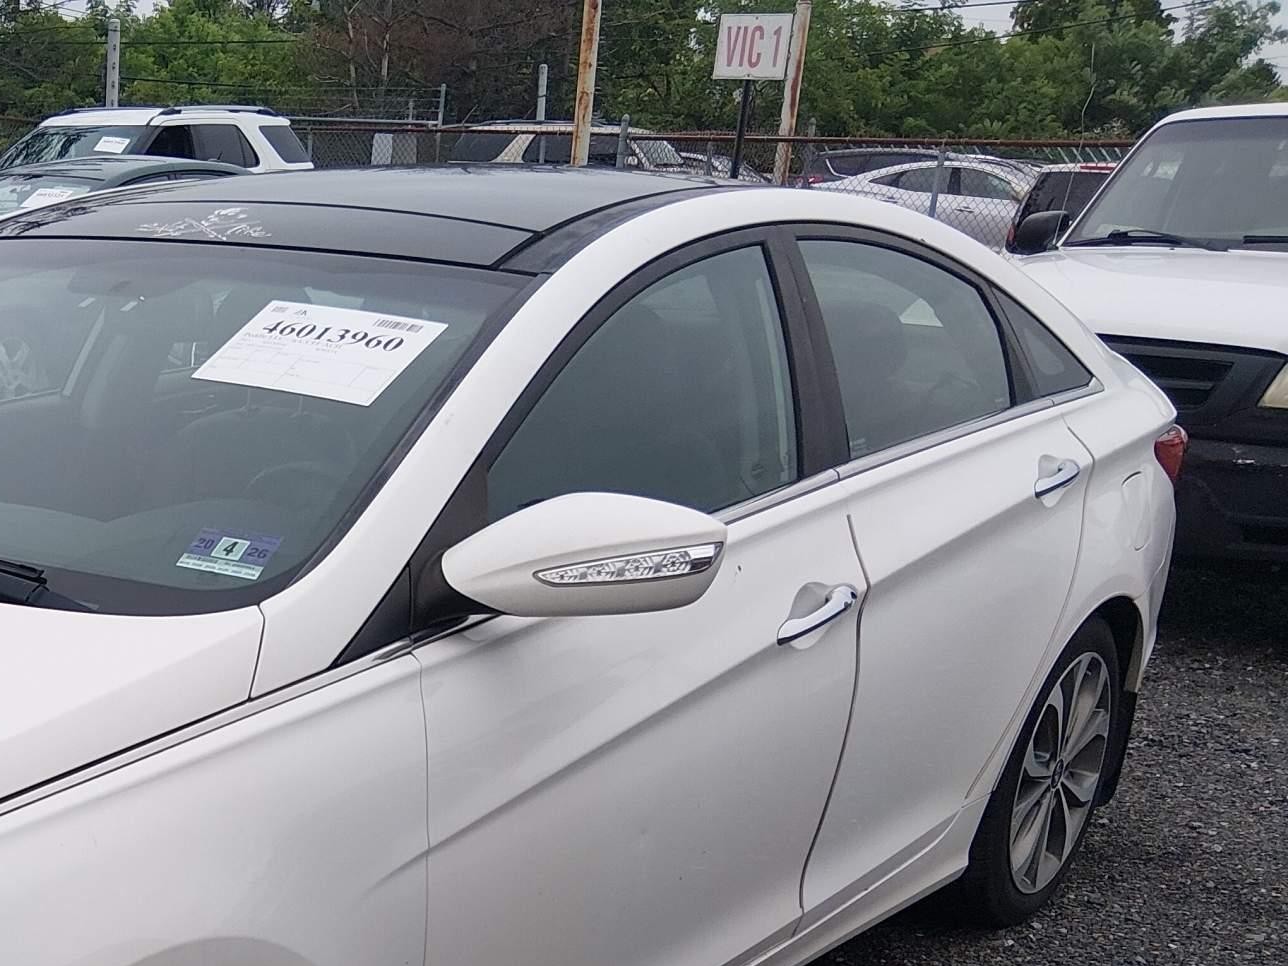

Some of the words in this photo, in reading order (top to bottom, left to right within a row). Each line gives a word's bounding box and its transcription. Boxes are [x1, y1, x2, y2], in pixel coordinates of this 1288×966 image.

[726, 25, 765, 68] VIC
[772, 25, 783, 68] 1
[262, 319, 405, 352] 46013960
[192, 537, 215, 550] 20
[222, 541, 239, 556] 4
[247, 547, 269, 560] 26
